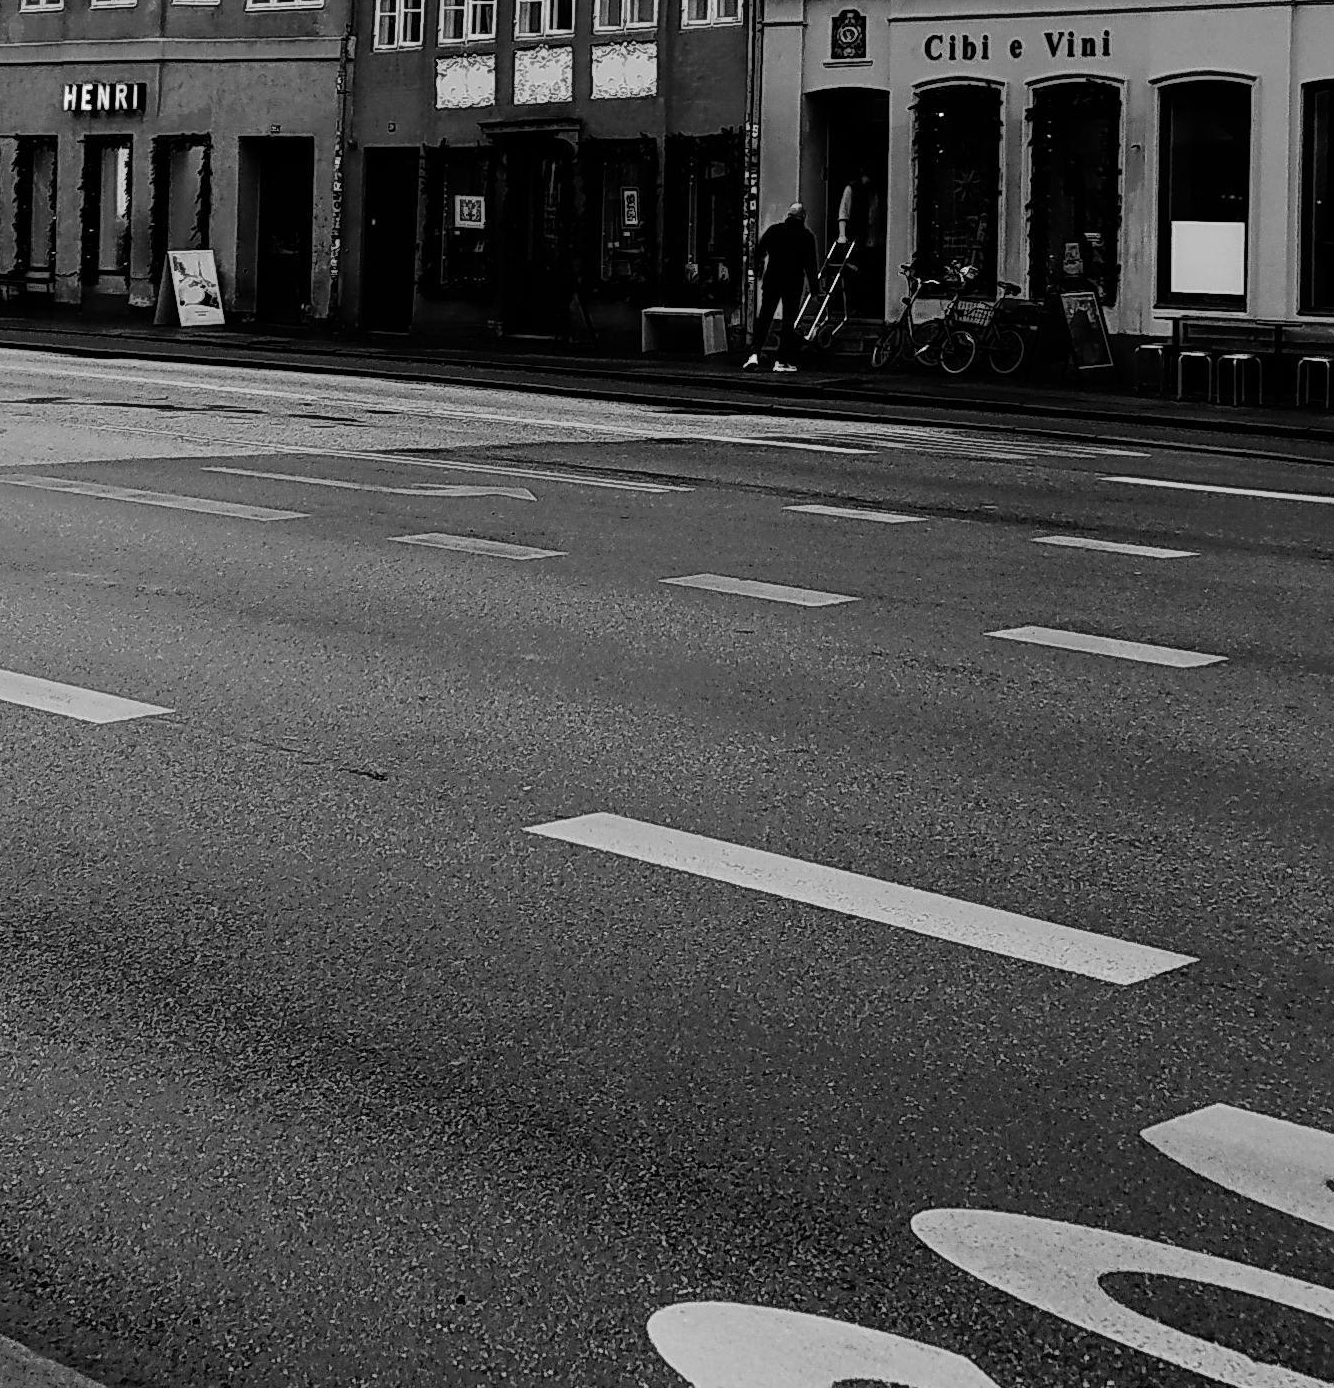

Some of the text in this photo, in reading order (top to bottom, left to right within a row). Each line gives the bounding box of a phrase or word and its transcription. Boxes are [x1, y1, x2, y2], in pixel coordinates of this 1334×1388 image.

[924, 29, 1111, 61] Cibi e Vini
[63, 83, 138, 111] HENRI
